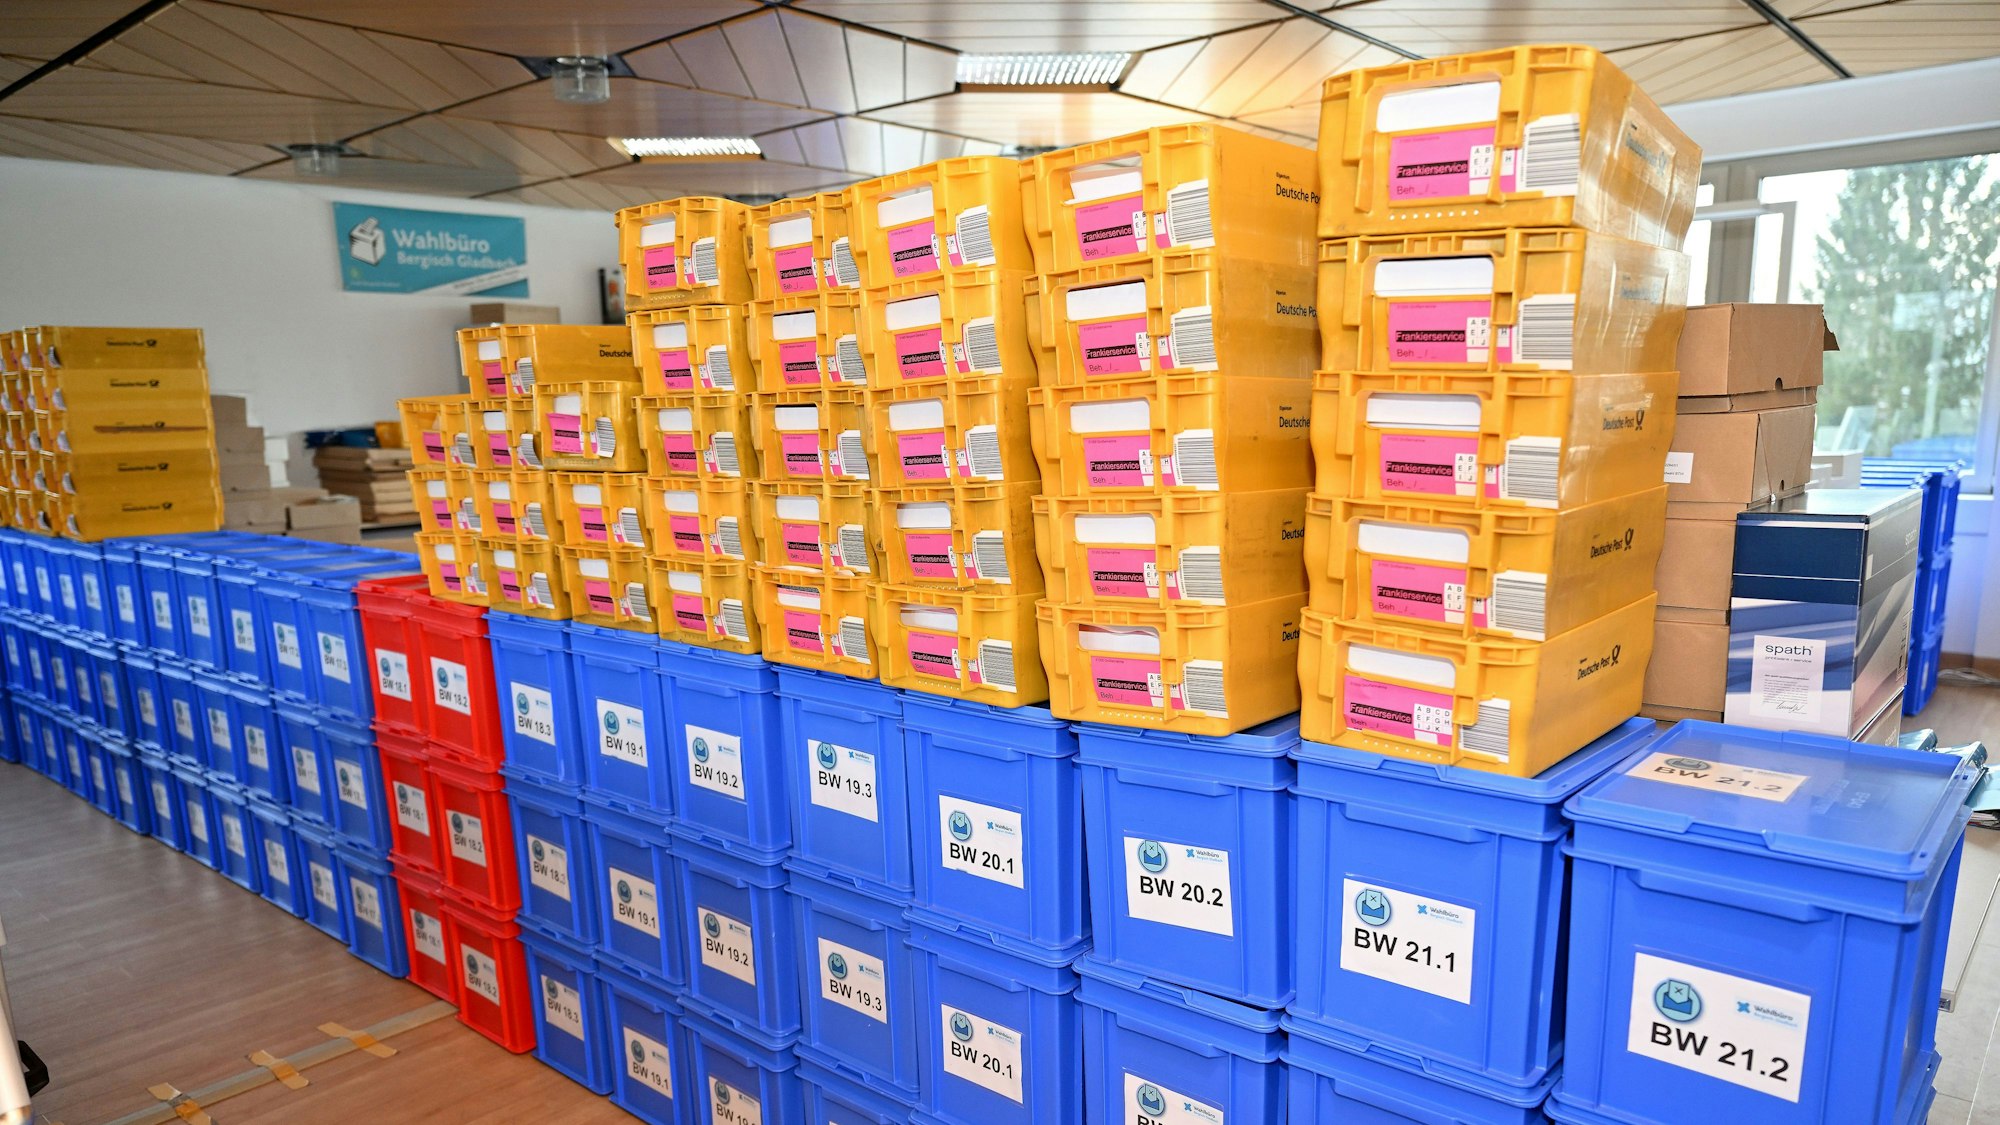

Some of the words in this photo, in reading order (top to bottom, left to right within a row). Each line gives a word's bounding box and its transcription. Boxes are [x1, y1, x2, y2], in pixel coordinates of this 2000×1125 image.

[1396, 161, 1468, 178] Frankierservice
[1276, 184, 1308, 202] Deutsche
[393, 229, 489, 252] Wahlbüro
[1082, 225, 1132, 242] Frankierservice
[397, 253, 454, 269] Bergisch
[1085, 247, 1098, 257] Beh
[1277, 302, 1307, 316] Deutsche
[1396, 331, 1465, 342] Frankierservice
[1086, 345, 1136, 359] Frankierservice
[1397, 349, 1414, 357] Beh
[1089, 363, 1103, 372] Beh
[1090, 461, 1140, 471] Frankierservice
[1386, 462, 1453, 476] Frankierservice
[1387, 479, 1403, 487] Beh
[1591, 544, 1612, 559] Deutsche
[1612, 540, 1623, 552] Post
[1093, 571, 1143, 582] Frankierservice
[1377, 587, 1442, 604] Frankierservice
[1378, 602, 1395, 610] Beh
[1765, 644, 1812, 656] spath
[1578, 661, 1599, 680] Deutsche
[1600, 656, 1610, 671] Post
[382, 678, 393, 690] BW
[1097, 678, 1147, 691] Frankierservice
[439, 689, 452, 700] BW
[454, 693, 468, 707] 18.2
[1350, 702, 1412, 724] Frankierservice
[518, 716, 532, 730] BW
[534, 721, 551, 736] 18.3
[606, 736, 623, 751] BW
[626, 741, 643, 758] 19.1
[695, 764, 713, 781] BW
[716, 771, 738, 788] 19.2
[819, 771, 841, 789] BW
[846, 778, 872, 798] 19.3
[1654, 766, 1710, 779] BW
[1715, 776, 1783, 792] 21.2
[400, 804, 412, 816] BW
[454, 834, 467, 847] BW
[469, 839, 482, 852] 18.2
[950, 843, 976, 864] BW
[982, 851, 1014, 874] 20.1
[534, 861, 548, 876] BW
[1140, 875, 1174, 897] BW
[1181, 883, 1223, 907] 20.2
[619, 903, 635, 919] BW
[638, 911, 656, 929] 19.1
[1430, 906, 1459, 918] Wahlbüro
[416, 929, 428, 941] BW
[706, 938, 724, 955] BW
[728, 947, 748, 966] 19.2
[1354, 928, 1397, 956] BW
[1405, 941, 1455, 972] 21.1
[469, 973, 482, 988] BW
[483, 979, 497, 998] 18.2
[830, 979, 851, 999] BW
[857, 990, 882, 1011] 19.3
[547, 999, 561, 1014] BW
[564, 1004, 579, 1023] 18.3
[1754, 1004, 1793, 1021] Wahlbüro
[951, 1041, 978, 1064] BW
[982, 1054, 1012, 1079] 20.1
[1651, 1022, 1708, 1056] BW
[1718, 1042, 1789, 1082] 21.2
[633, 1062, 648, 1079] BW
[651, 1071, 669, 1090] 19.1
[717, 1103, 733, 1122] BW
